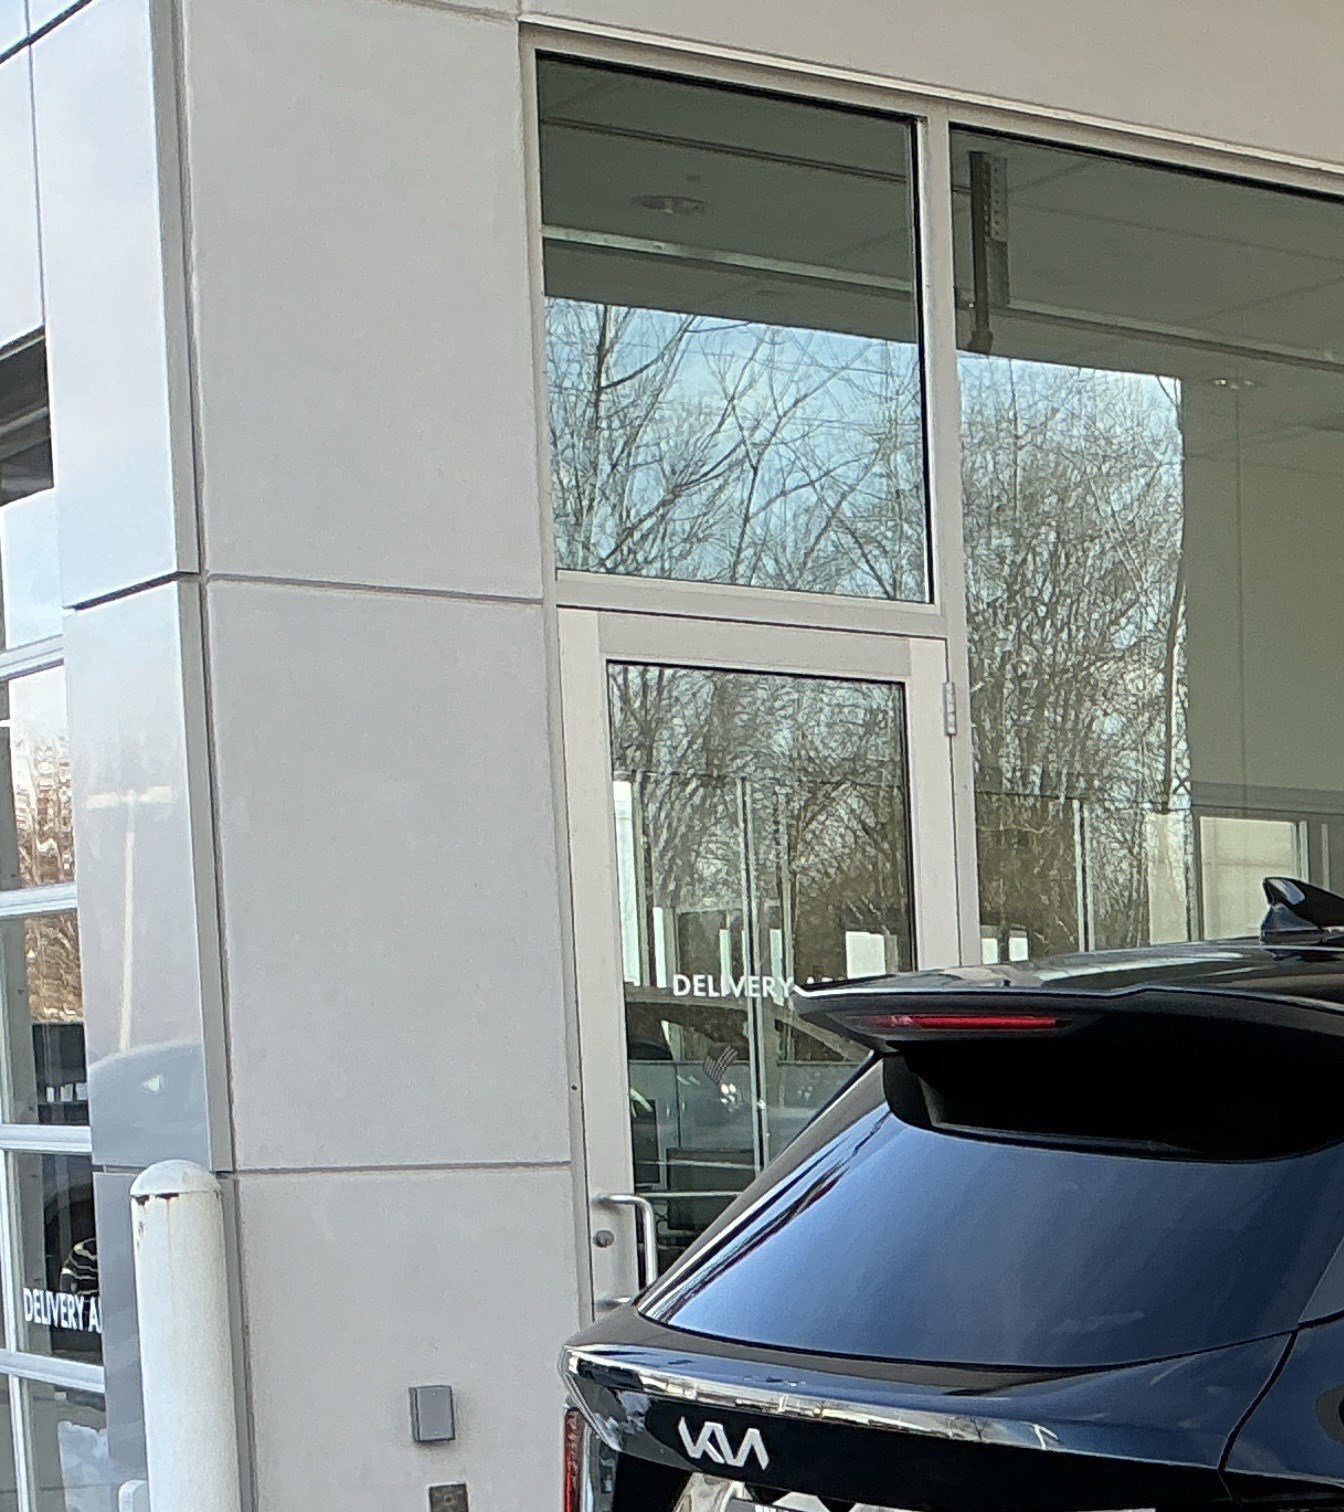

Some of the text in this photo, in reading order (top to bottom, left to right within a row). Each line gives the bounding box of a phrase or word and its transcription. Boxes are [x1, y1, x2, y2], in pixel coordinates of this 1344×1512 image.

[672, 973, 794, 998] DELIVERY
[22, 1287, 84, 1331] DELIVERY
[678, 1416, 770, 1471] KIA
